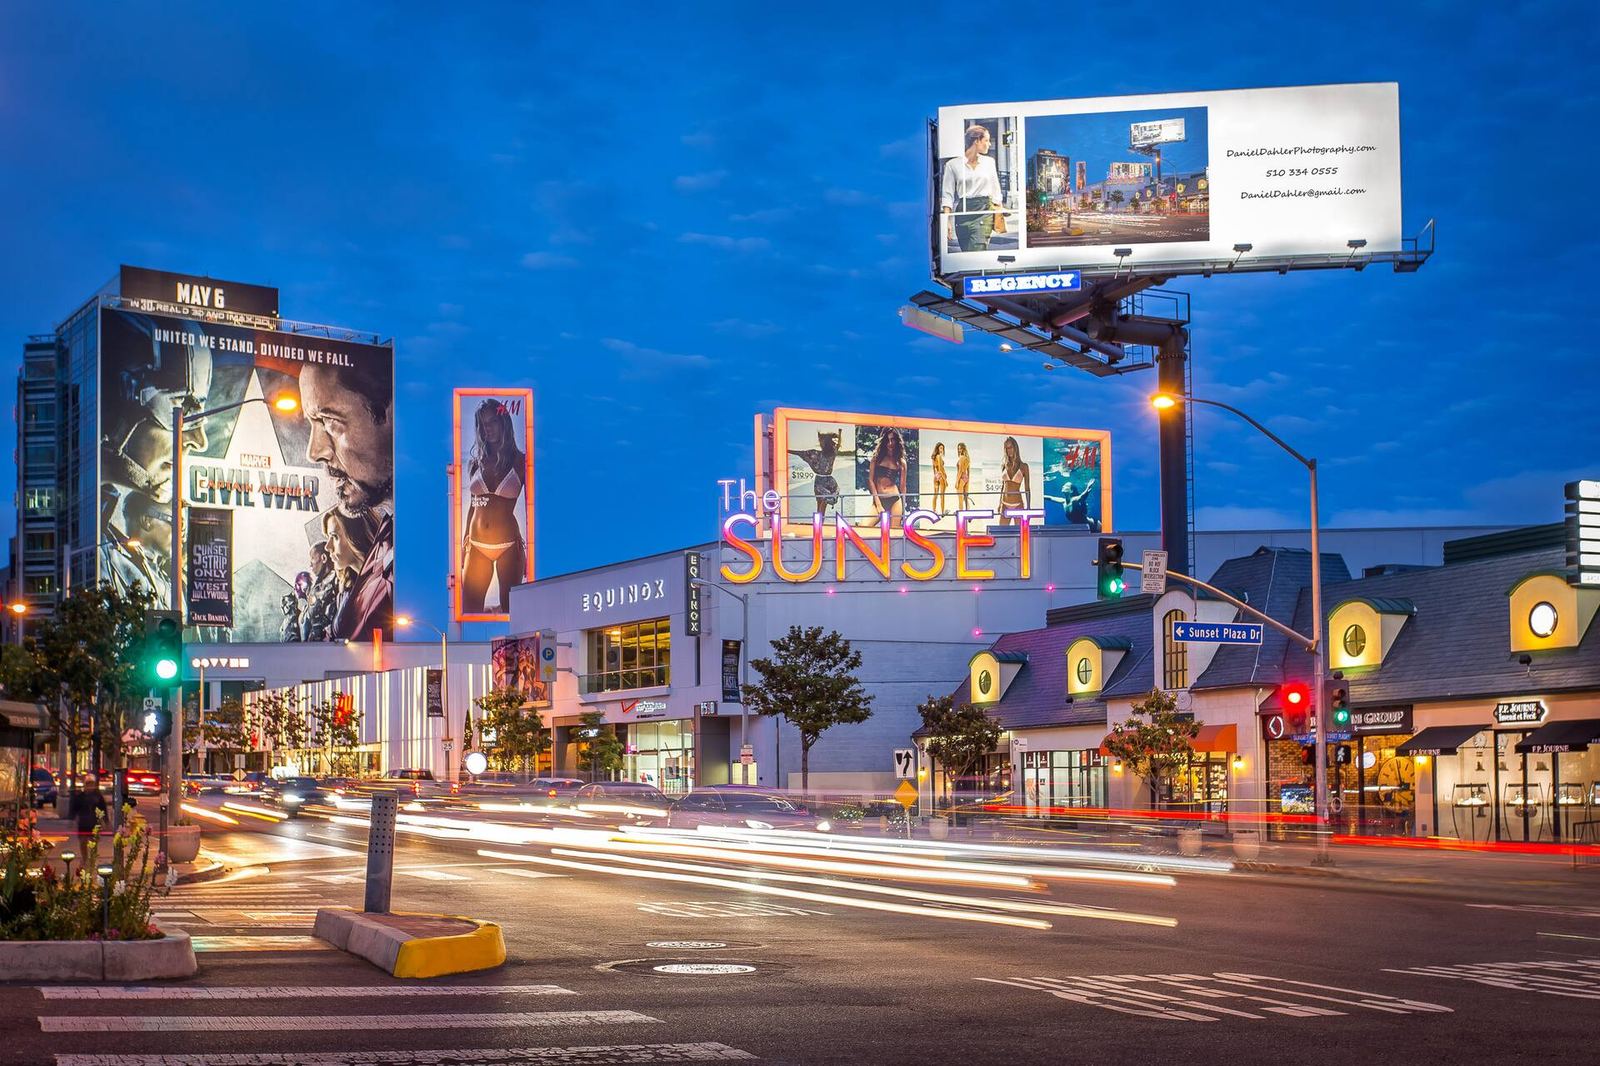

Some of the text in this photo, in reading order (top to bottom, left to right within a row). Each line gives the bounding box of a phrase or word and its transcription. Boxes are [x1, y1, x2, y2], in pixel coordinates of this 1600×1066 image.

[1226, 144, 1377, 158] DanielDahlerPhotography.com
[1266, 166, 1338, 178] 510 334 0555
[1240, 186, 1367, 200] DanielDahler@gmail.com
[970, 273, 1075, 293] REGENCY
[176, 281, 225, 309] MAY 6
[130, 299, 140, 308] IN
[205, 310, 225, 320] AND
[154, 328, 354, 368] UNITED WE STAND. DIVIDED WE FALL.
[241, 454, 271, 468] MARVEL
[791, 471, 815, 479] $19.99
[189, 465, 320, 512] CIVIL WAR
[258, 484, 313, 497] AMERICA
[718, 478, 780, 511] The
[193, 541, 228, 565] SUNSET
[720, 509, 1046, 583] SUNSET
[202, 555, 228, 570] STRIP
[194, 569, 228, 579] ONLY
[194, 582, 228, 591] WEST
[192, 590, 229, 600] HOLLYWOOD
[582, 579, 665, 612] EQUINOX
[192, 613, 207, 622] JACK
[1188, 626, 1260, 640] Sunset Plaza Dr
[1498, 703, 1537, 713] F.P. JOURNE
[1363, 711, 1404, 724] GROUP
[1532, 744, 1570, 753] F.P. JOURNE
